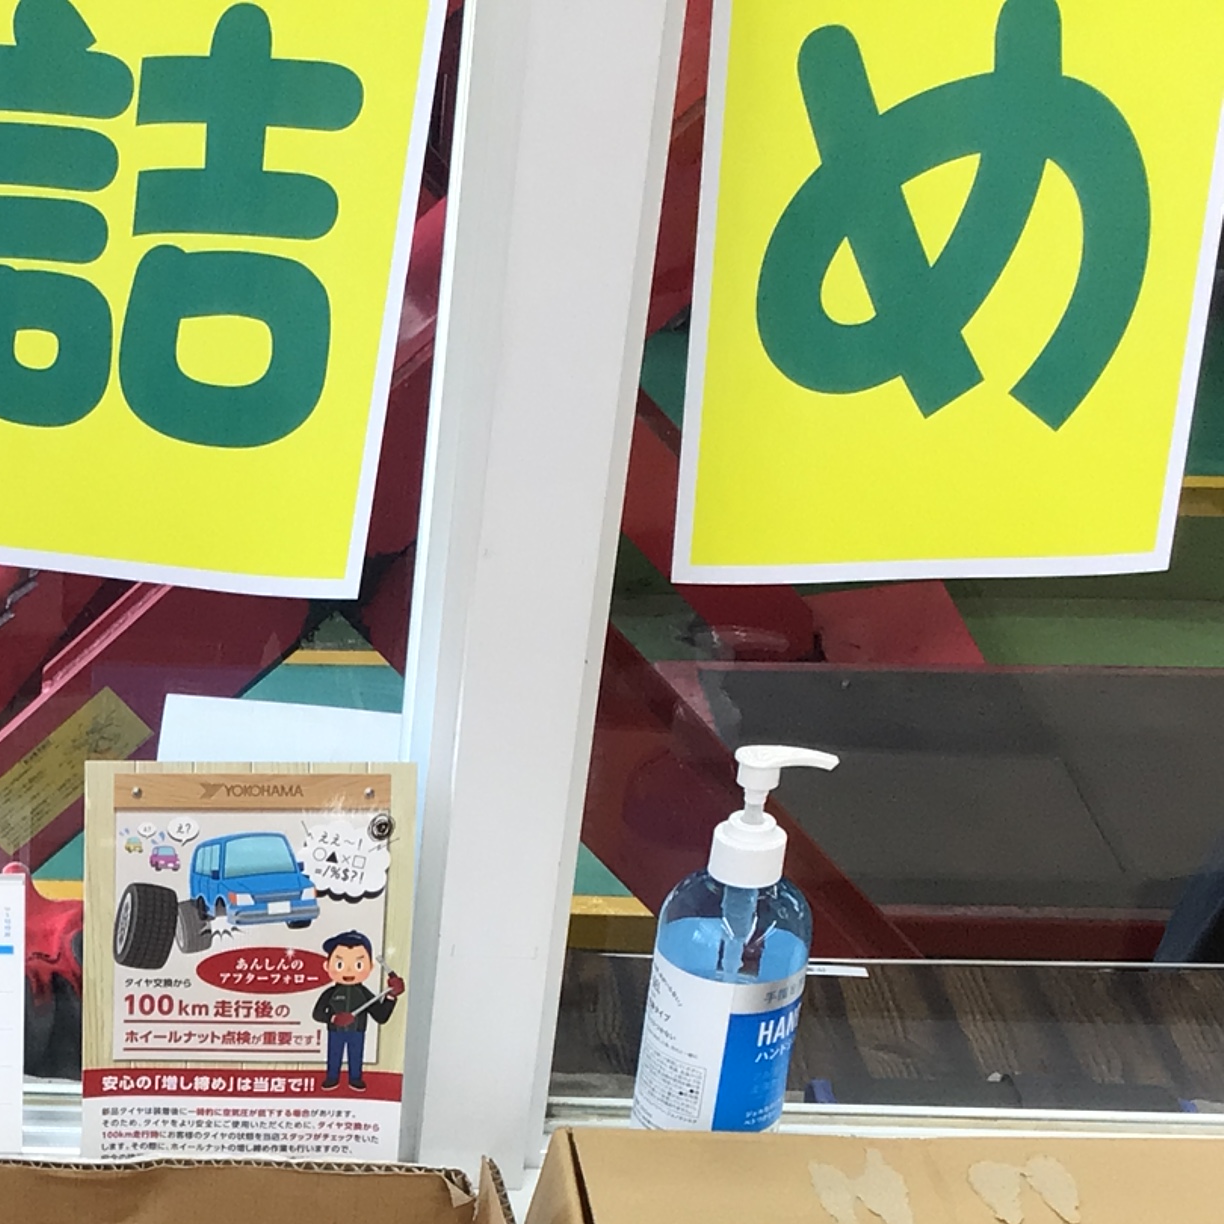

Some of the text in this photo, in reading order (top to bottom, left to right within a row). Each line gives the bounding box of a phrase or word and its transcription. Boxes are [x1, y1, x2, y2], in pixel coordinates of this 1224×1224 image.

[756, 0, 1151, 432] め
[225, 784, 304, 798] YOKOHAMA
[235, 956, 304, 972] あんしんの
[125, 977, 192, 989] タイヤ交換から
[219, 972, 320, 985] アフターフォロー
